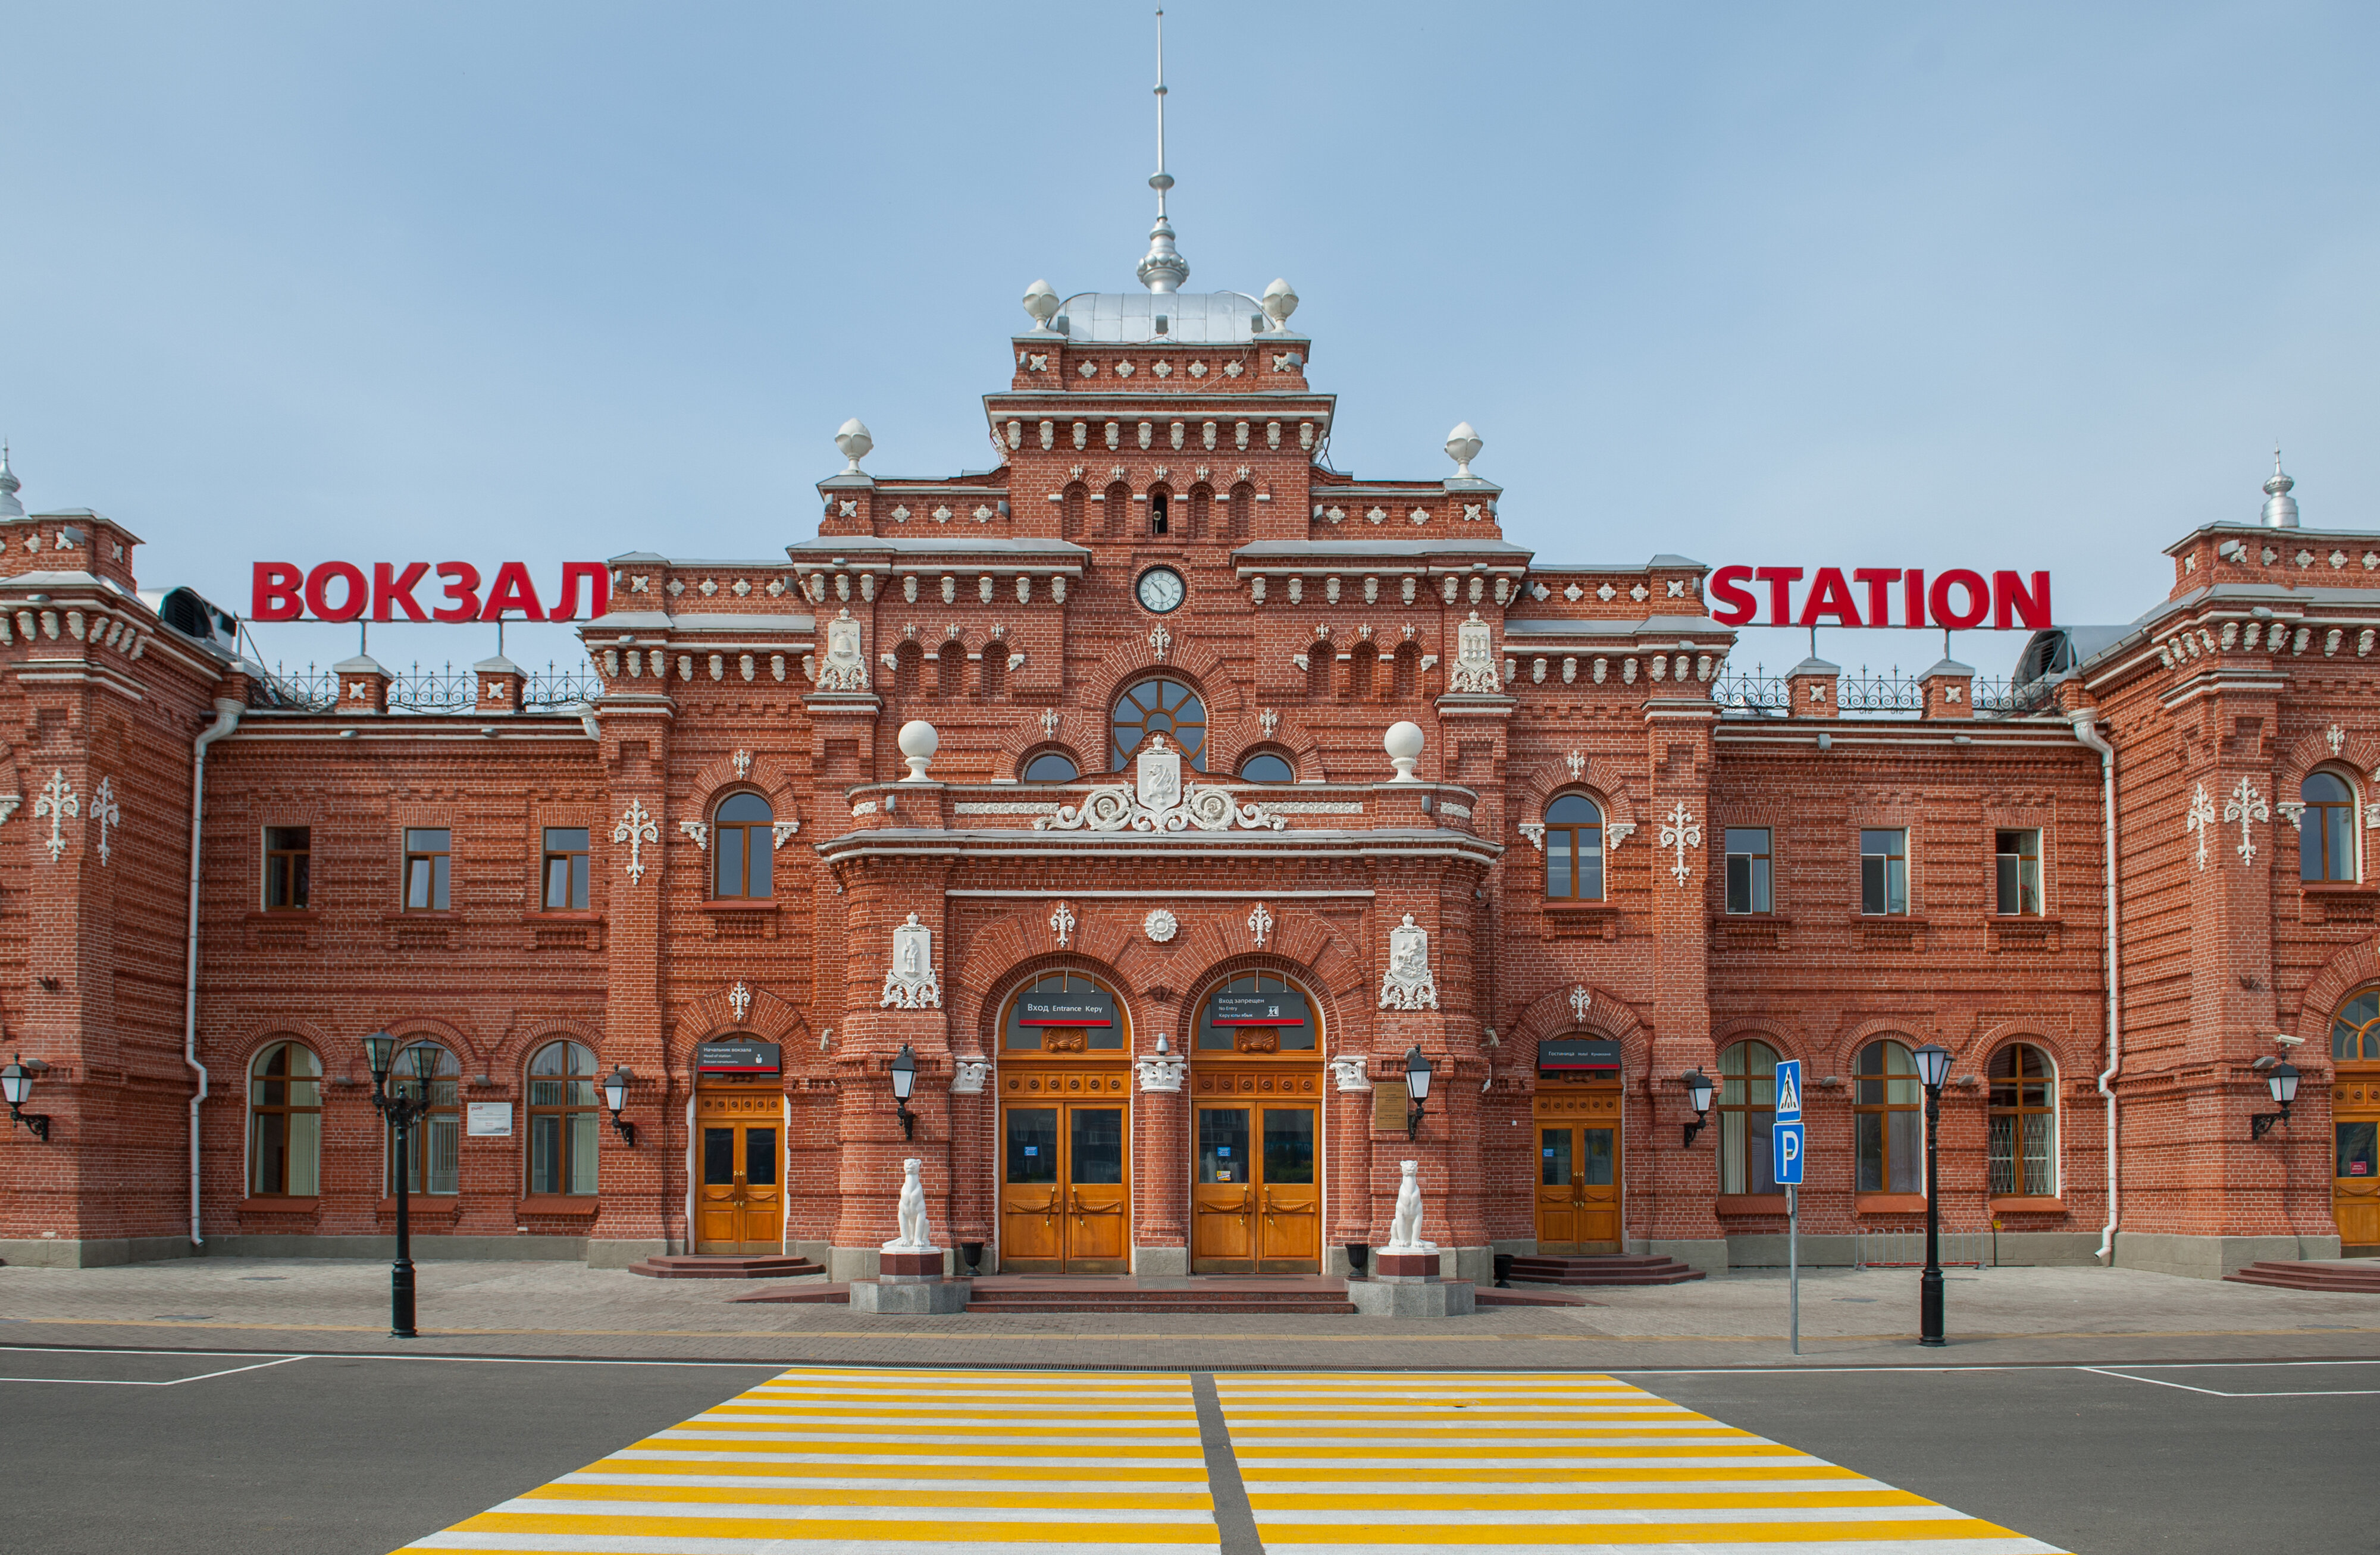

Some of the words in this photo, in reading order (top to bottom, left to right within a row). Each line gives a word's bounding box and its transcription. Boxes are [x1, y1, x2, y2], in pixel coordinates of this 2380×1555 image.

[252, 560, 610, 623] ВОКЗАЛ
[1709, 565, 2052, 631] STATION
[1028, 1004, 1049, 1012] Вход
[1782, 1130, 1799, 1177] P
